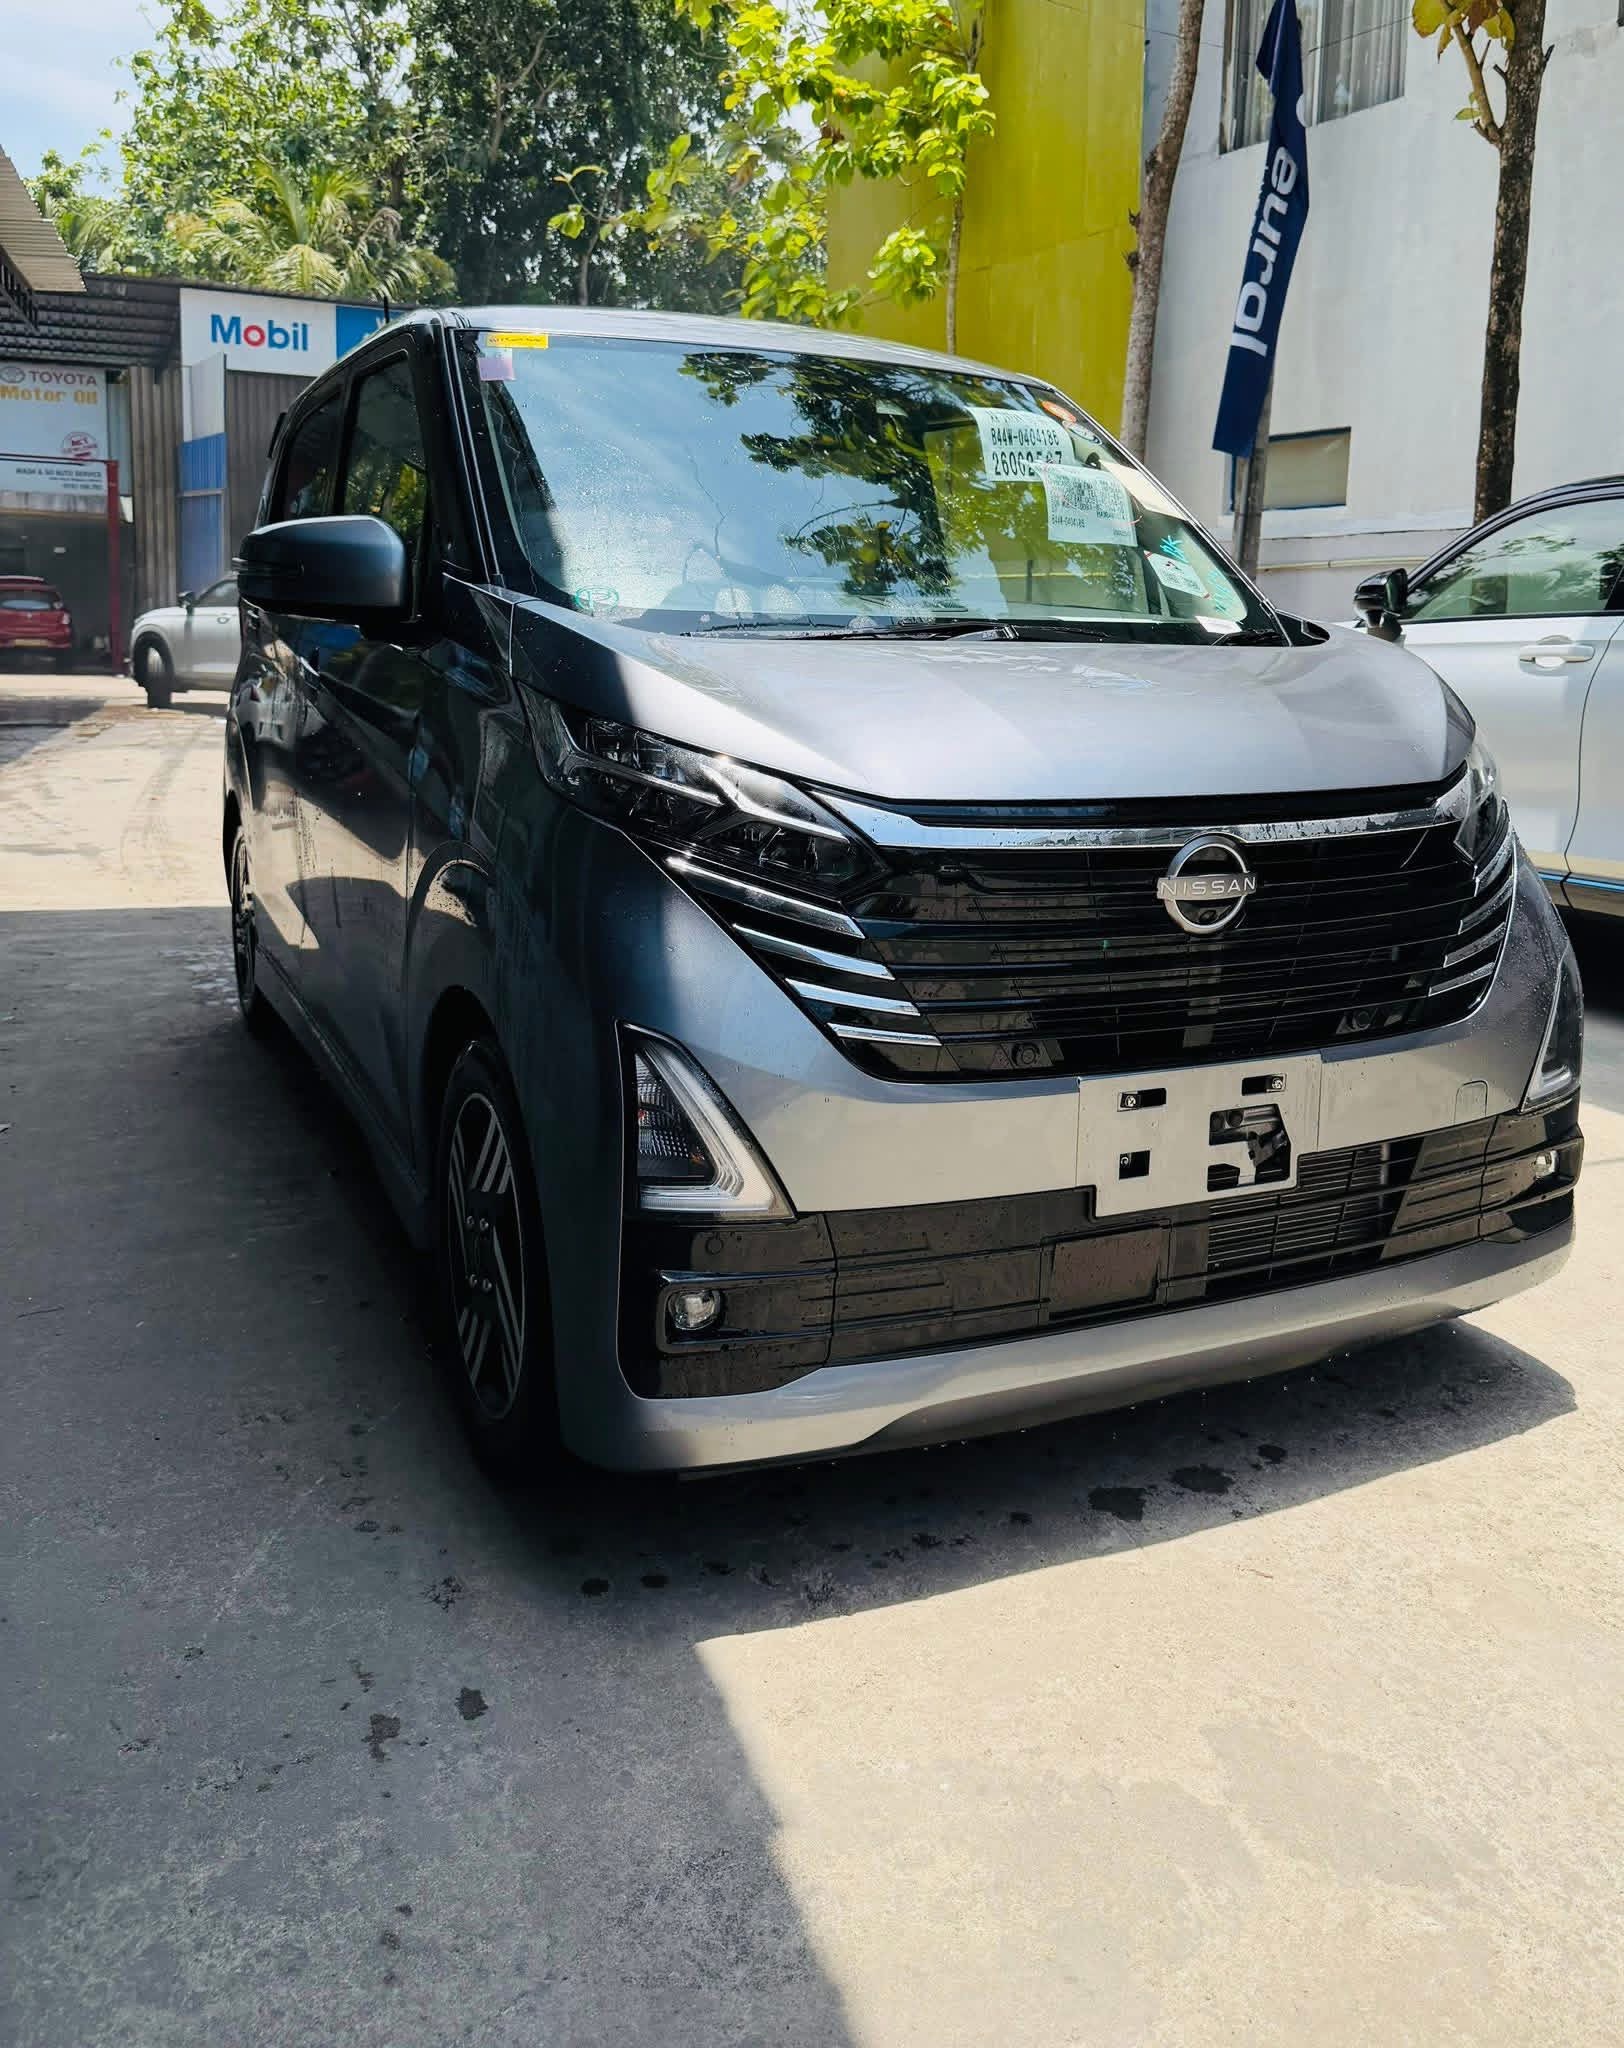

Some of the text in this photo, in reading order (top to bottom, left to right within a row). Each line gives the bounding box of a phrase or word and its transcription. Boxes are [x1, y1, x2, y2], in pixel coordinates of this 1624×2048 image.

[211, 313, 309, 352] Mobil
[28, 370, 97, 386] TOYOTA
[0, 385, 66, 402] Motor
[1159, 876, 1256, 897] NISSAN
